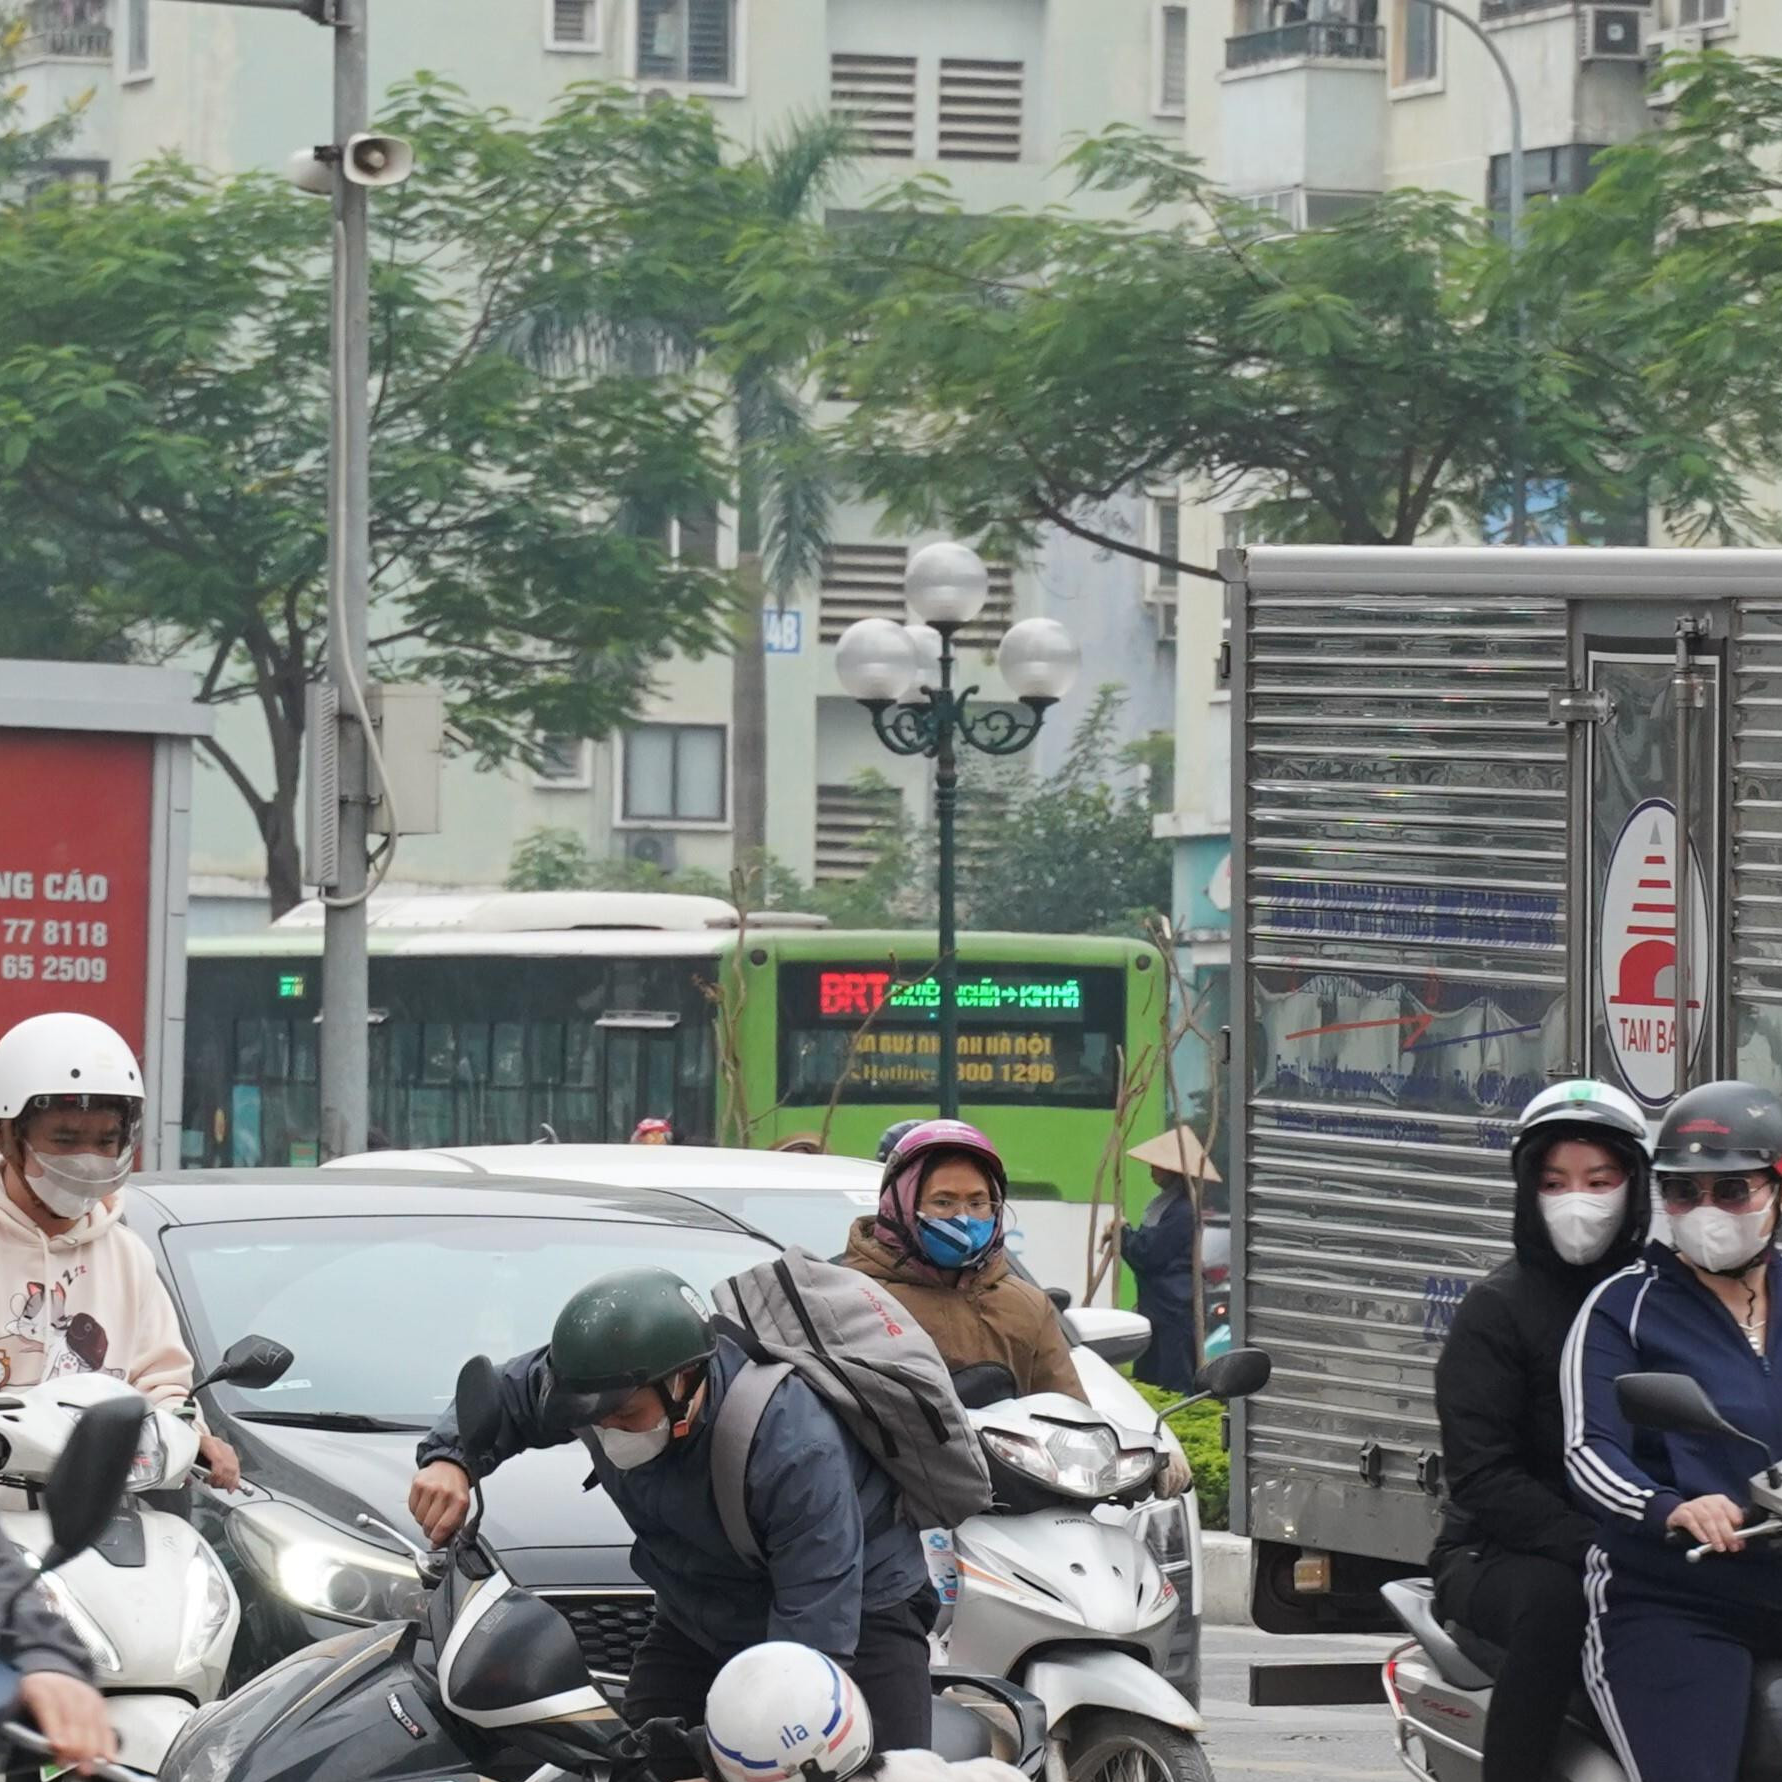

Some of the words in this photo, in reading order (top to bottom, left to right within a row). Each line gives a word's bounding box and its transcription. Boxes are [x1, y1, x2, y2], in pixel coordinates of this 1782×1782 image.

[44, 868, 108, 902] CÁO
[3, 918, 35, 944] 77
[43, 921, 108, 947] 8118
[2, 954, 34, 979] 65
[42, 957, 107, 983] 2509
[821, 973, 889, 1014] BRT
[1620, 1018, 1651, 1052] TAM
[1656, 1020, 1676, 1054] BA
[1001, 1063, 1055, 1083] 1296
[387, 1692, 425, 1739] HONDA
[780, 1724, 809, 1749] ila
